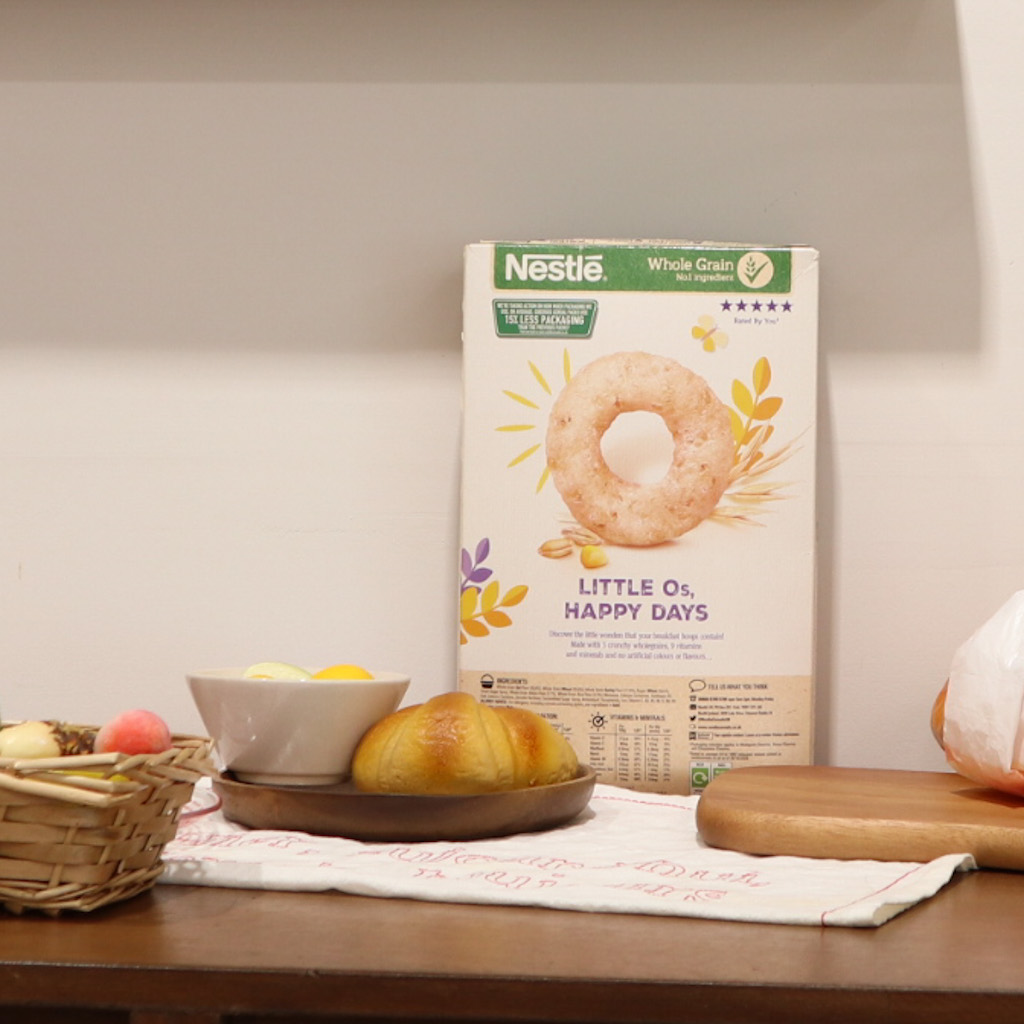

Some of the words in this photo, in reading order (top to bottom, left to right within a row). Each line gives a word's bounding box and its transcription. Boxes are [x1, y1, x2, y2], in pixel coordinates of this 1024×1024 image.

[505, 253, 604, 282] Nestlé
[647, 257, 693, 271] Whole
[695, 257, 735, 271] Grain
[520, 315, 539, 325] LESS
[540, 315, 585, 326] PACKAGING
[579, 578, 654, 596] LITTLE
[662, 579, 695, 600] Os,
[564, 602, 643, 621] HAPPY
[651, 603, 709, 622] DAYS
